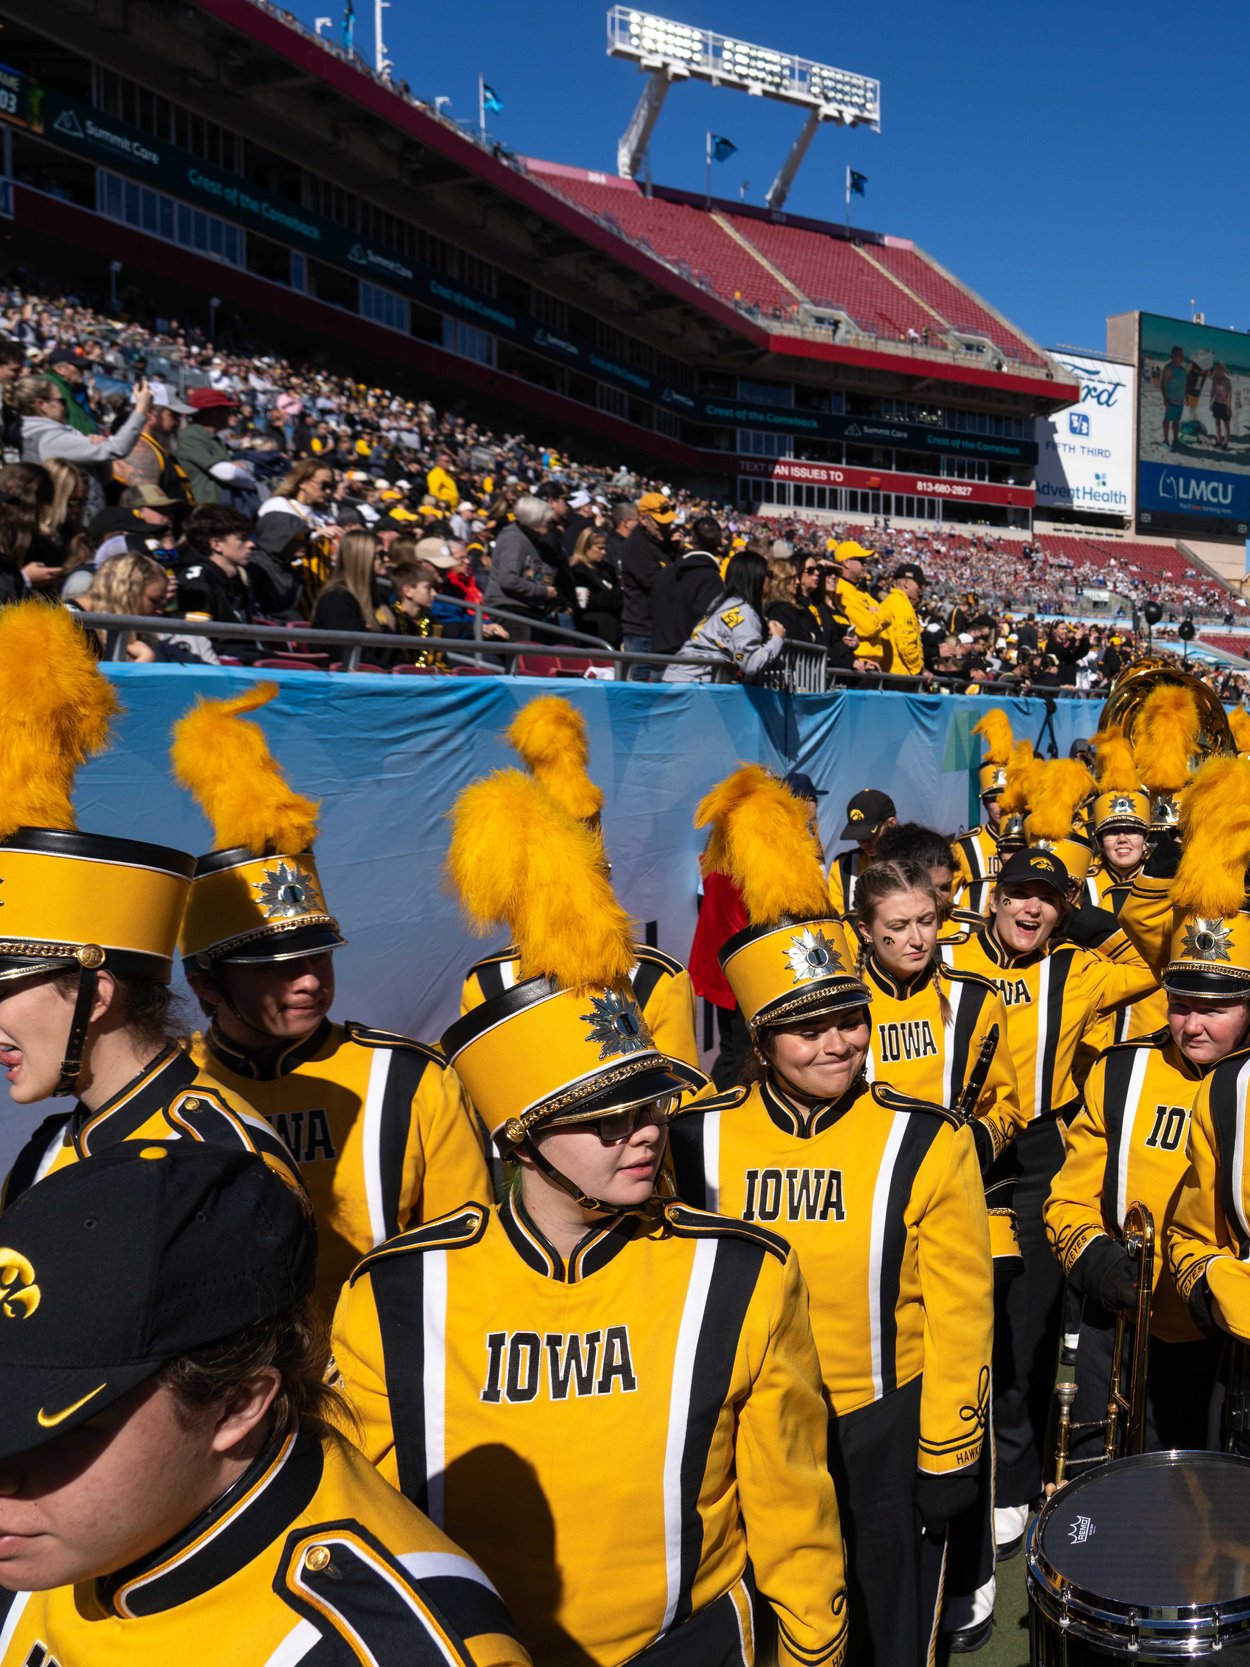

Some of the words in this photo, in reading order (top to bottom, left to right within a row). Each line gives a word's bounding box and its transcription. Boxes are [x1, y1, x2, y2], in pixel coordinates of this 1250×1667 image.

[85, 120, 131, 152] Summit
[131, 141, 160, 166] Care
[188, 168, 222, 196] Crest
[706, 404, 734, 417] Crest
[767, 413, 819, 429] Comeback
[926, 433, 950, 447] Crest
[977, 440, 1022, 456] Comeback
[1045, 440, 1076, 454] FIFTH
[1080, 445, 1111, 459] THIRD
[790, 465, 828, 482] ISSUES
[829, 470, 844, 482] TO
[1178, 476, 1233, 505] LMCU
[878, 1020, 938, 1062] IOWA
[1144, 1104, 1193, 1154] IO
[741, 1168, 848, 1222] IOWA
[479, 1324, 639, 1405] IOWA
[1077, 1517, 1088, 1541] REMO
